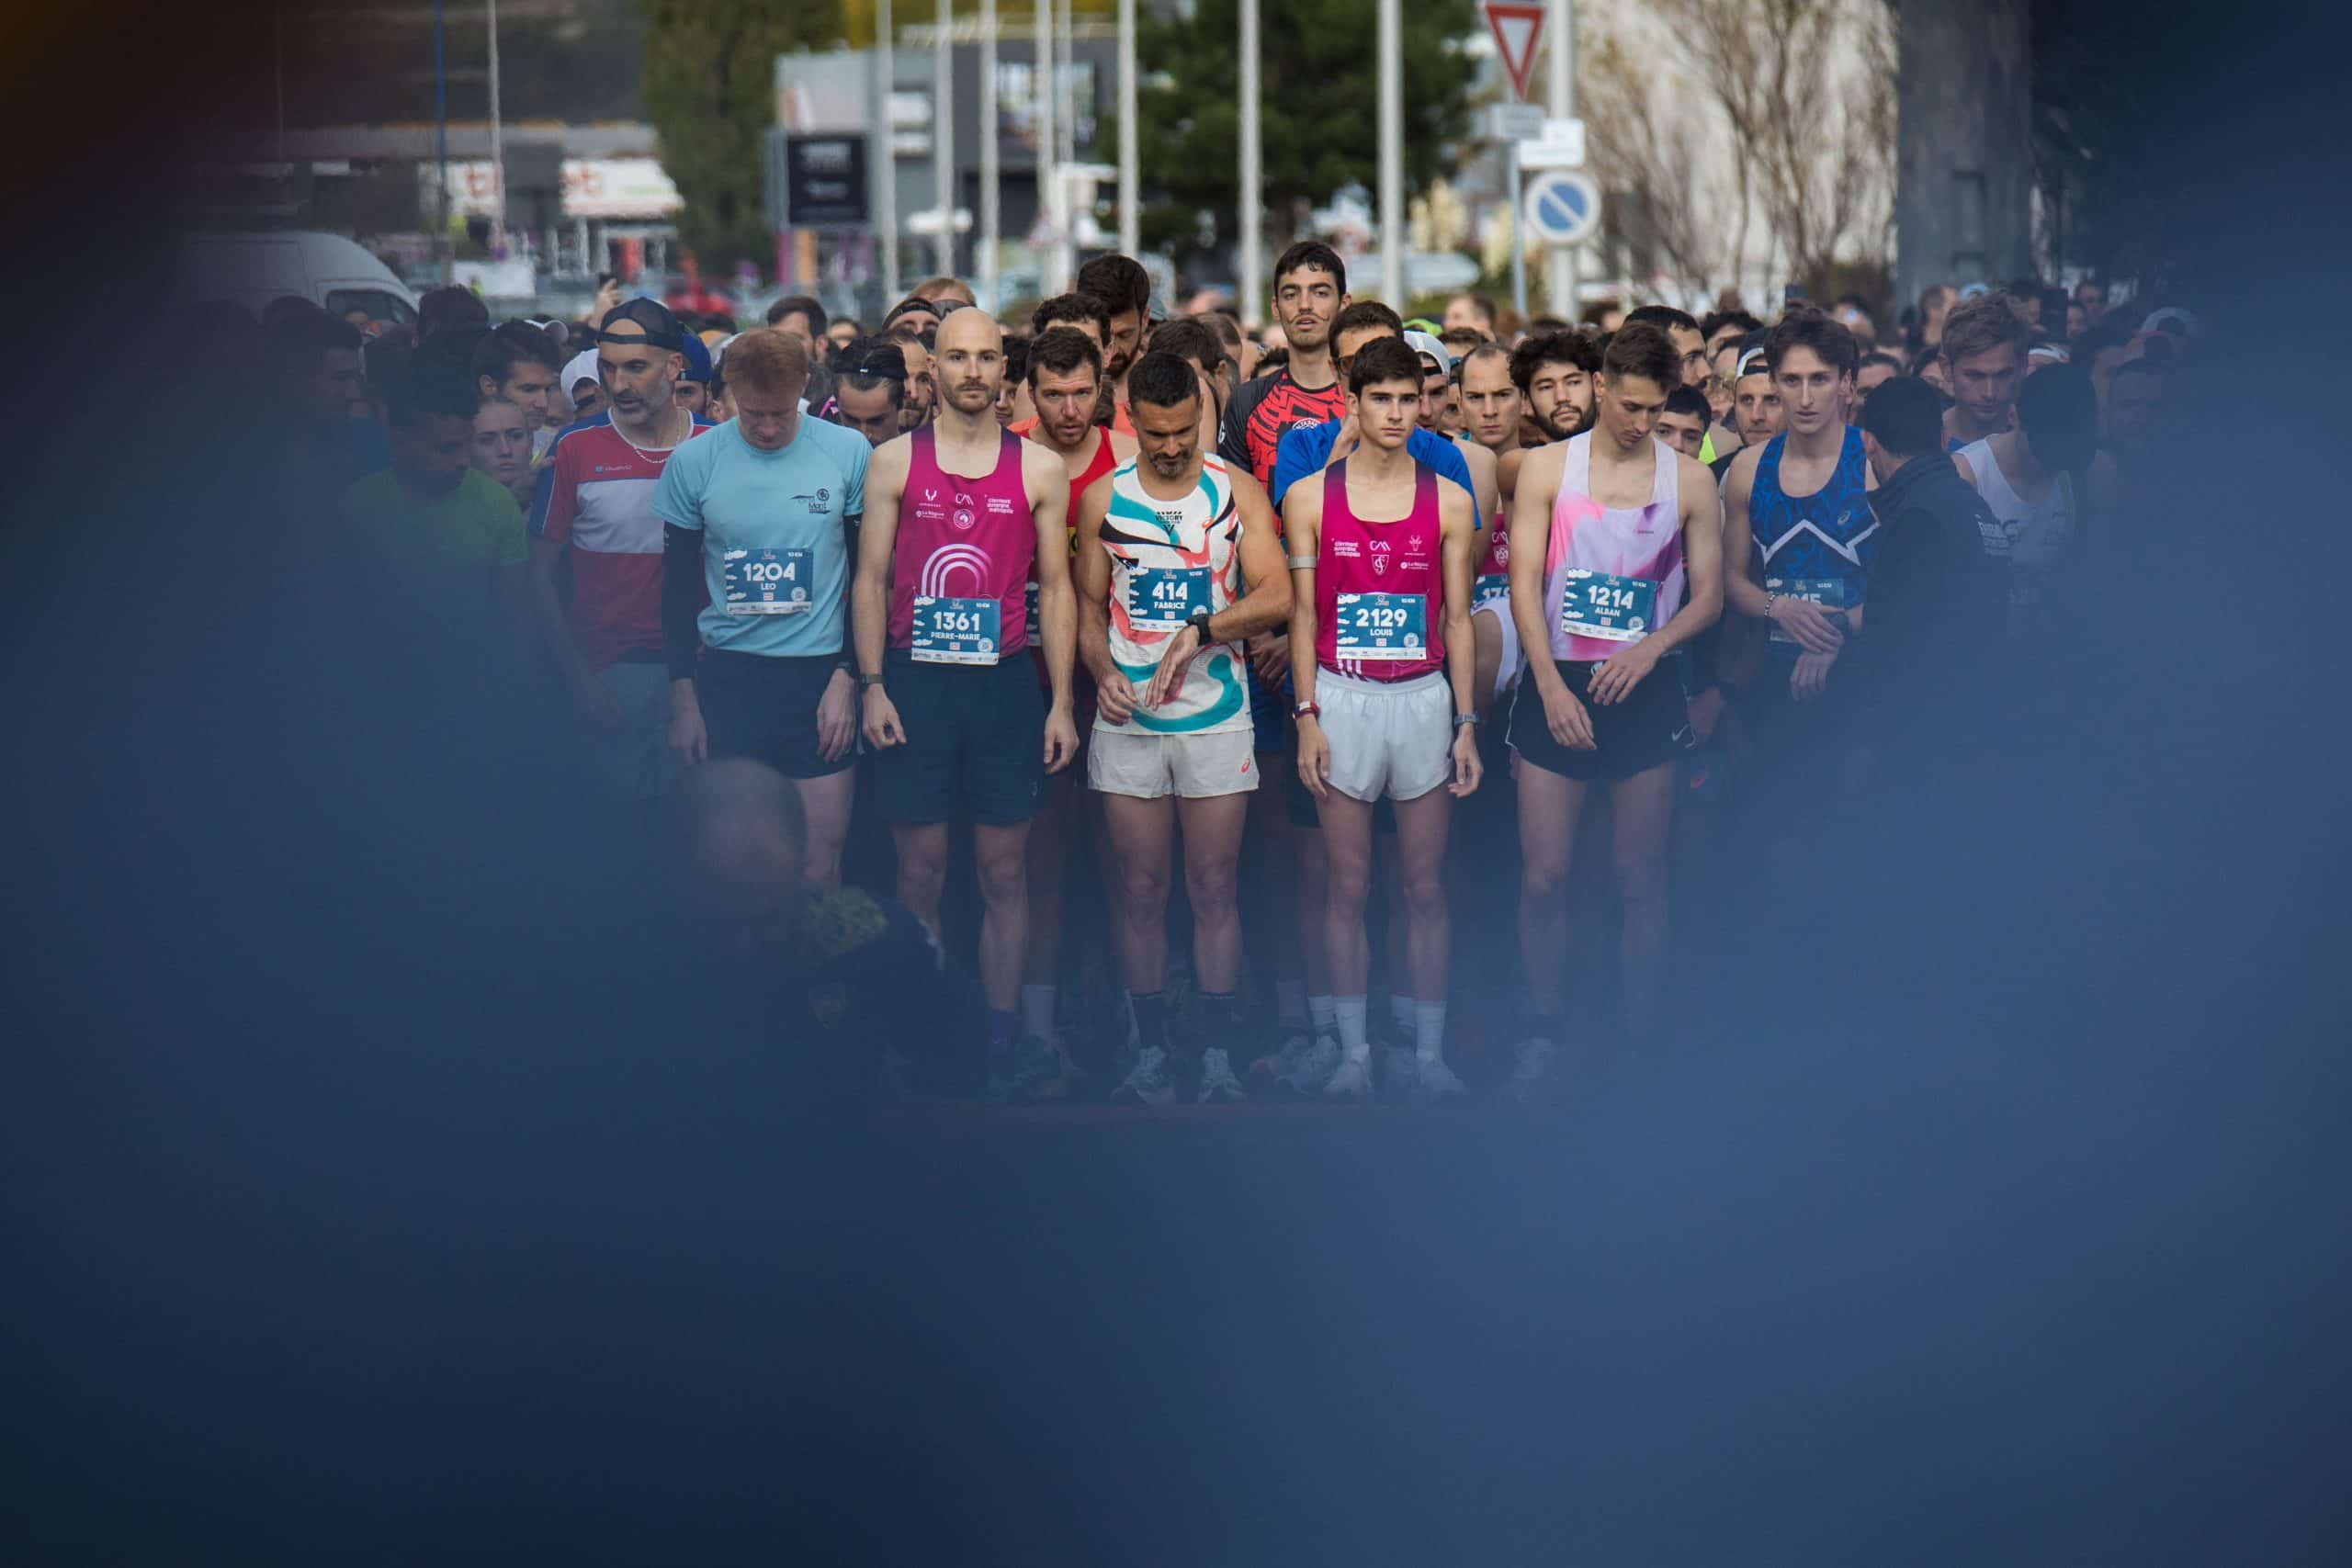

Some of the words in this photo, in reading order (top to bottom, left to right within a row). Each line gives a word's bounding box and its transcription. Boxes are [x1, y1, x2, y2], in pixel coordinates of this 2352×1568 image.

[743, 563, 795, 581] 1204
[1152, 581, 1188, 600] 414
[1588, 585, 1634, 609] 1214
[1356, 608, 1407, 626] 2129
[1595, 607, 1620, 616] ALBAN
[933, 611, 980, 632] 1361
[931, 632, 980, 640] PIERRE-MARIE
